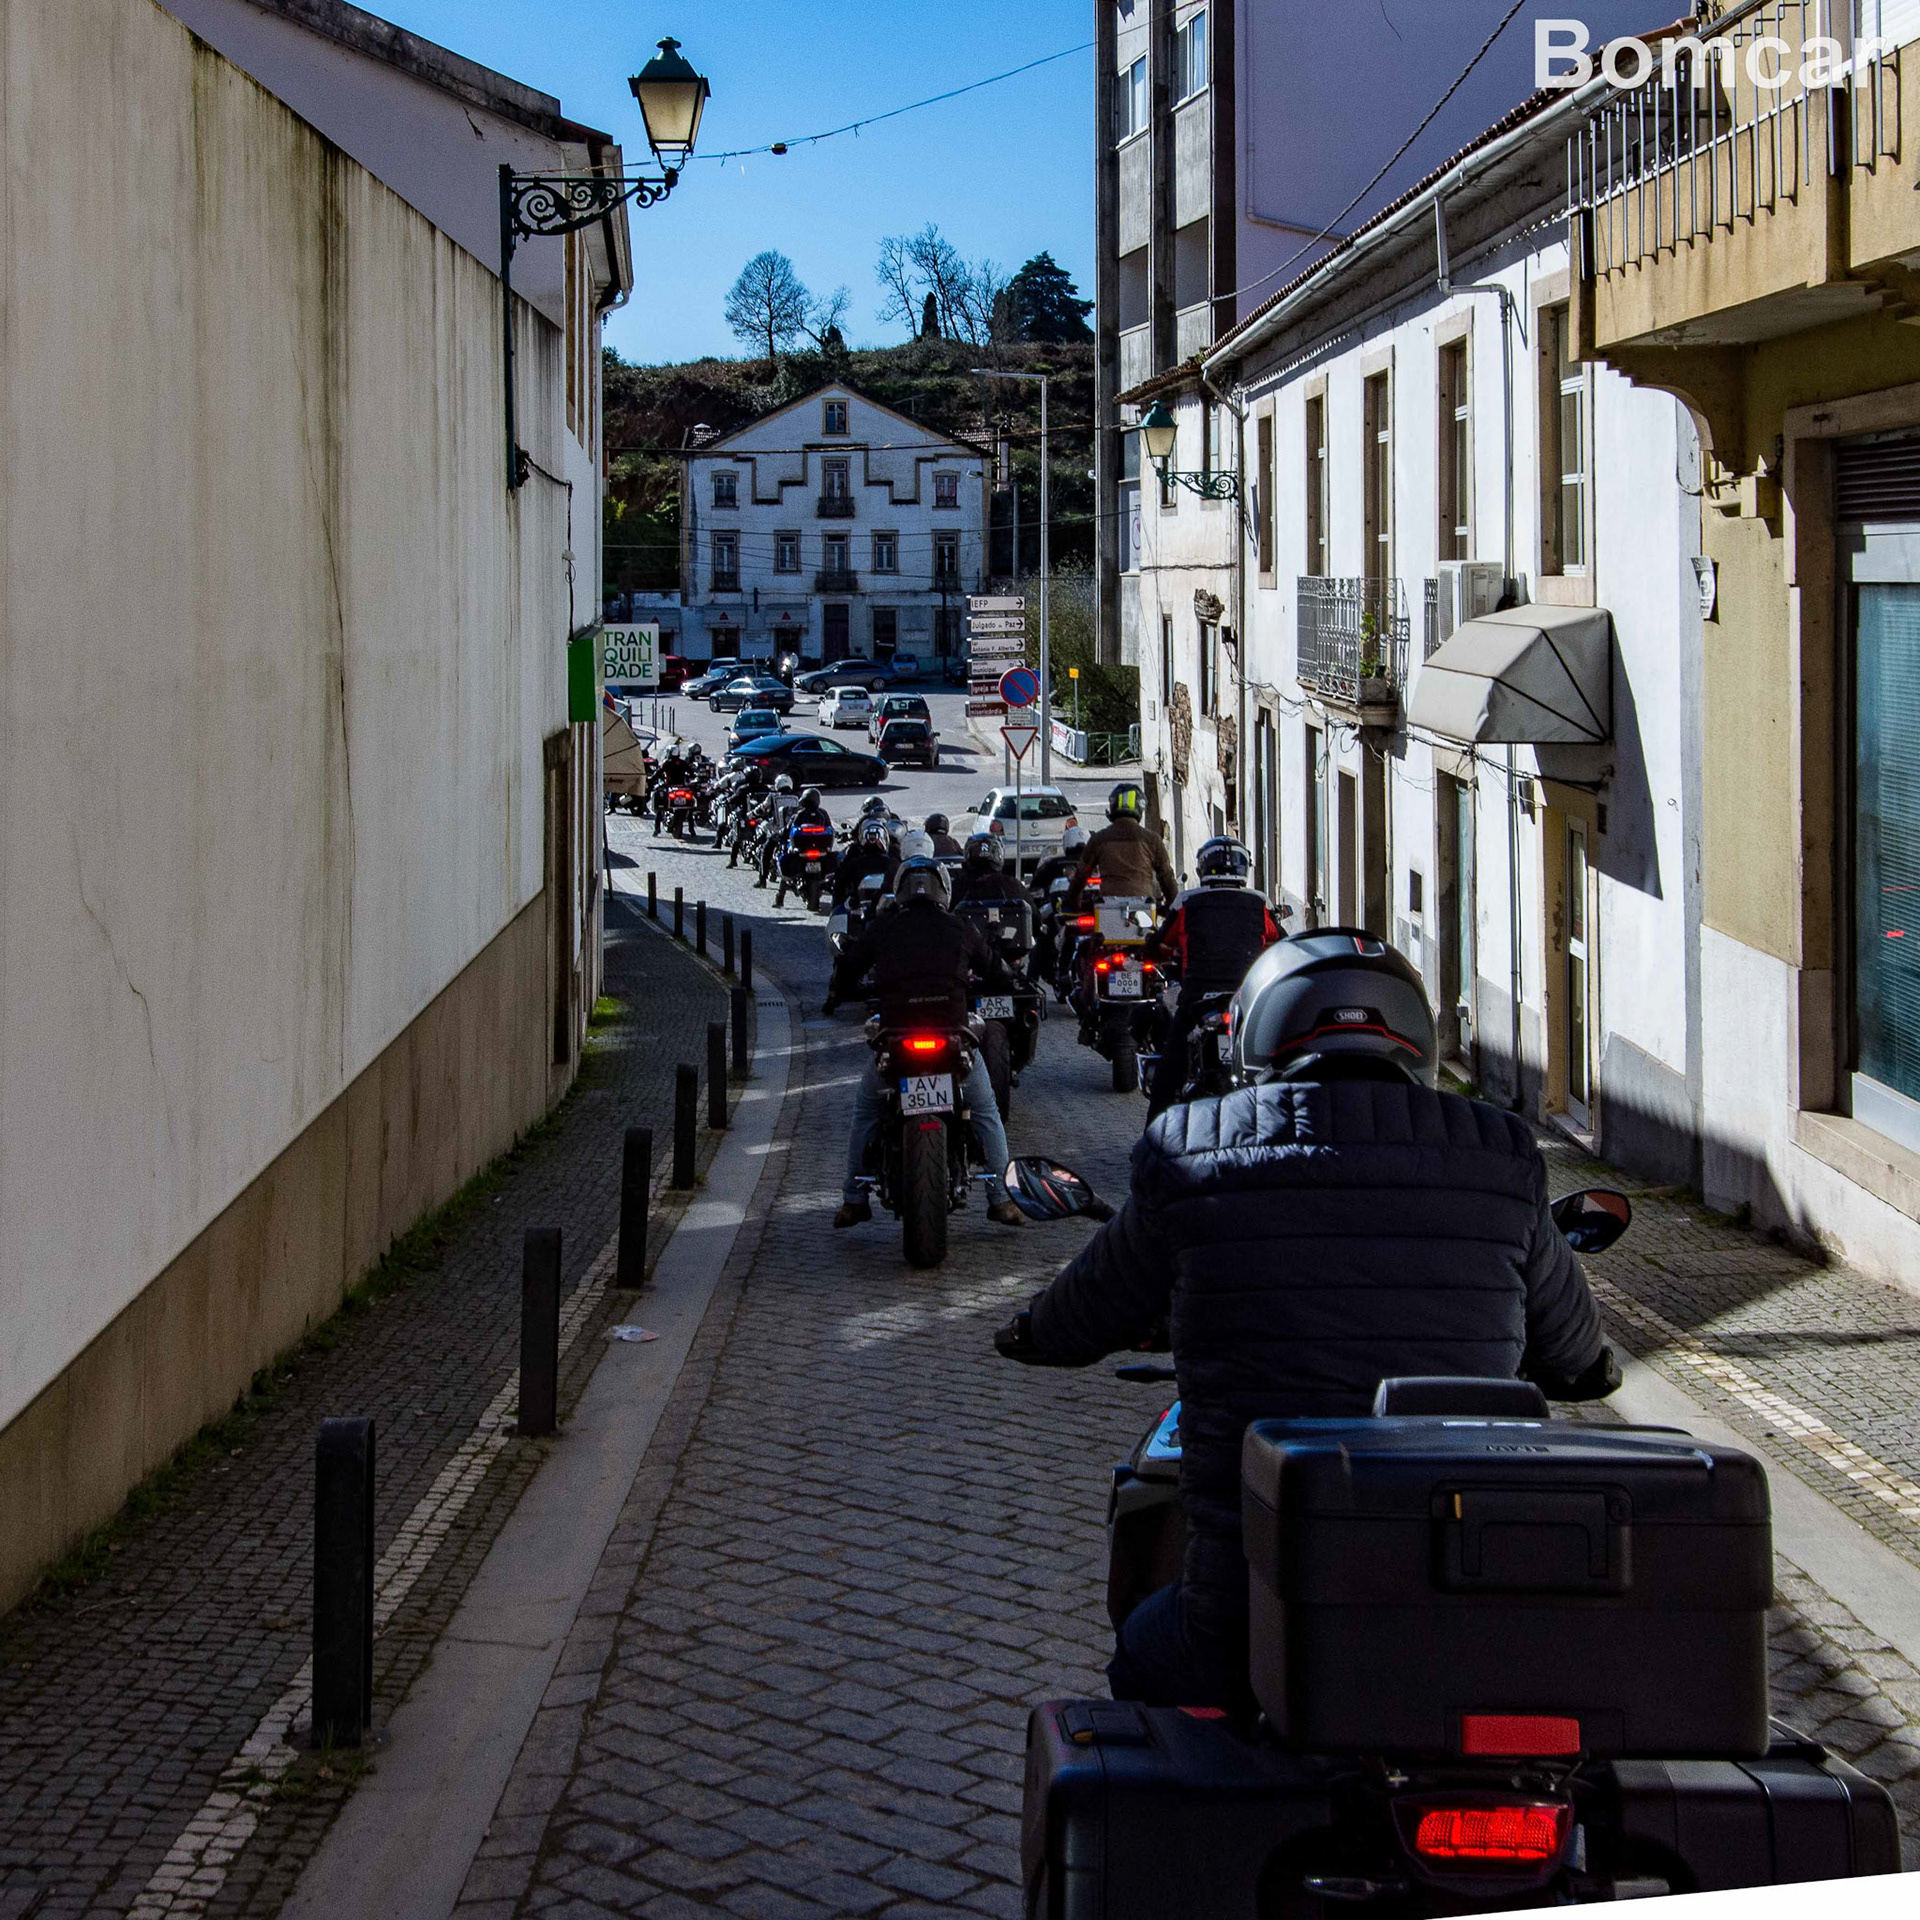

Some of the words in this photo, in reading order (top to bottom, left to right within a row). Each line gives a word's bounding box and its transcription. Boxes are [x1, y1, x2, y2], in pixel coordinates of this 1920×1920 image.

[972, 599, 988, 608] IEFP
[972, 621, 996, 630] Julgado
[1005, 621, 1016, 629] Paz
[604, 631, 652, 646] TRAN
[604, 647, 652, 664] QUILI
[604, 663, 653, 678] DADE
[1121, 972, 1132, 980] BE
[1121, 986, 1133, 994] AC
[986, 997, 1004, 1007] AR
[980, 1006, 1011, 1017] 92ZR
[1339, 1011, 1364, 1020] SHOEI
[915, 1077, 938, 1092] AV
[907, 1090, 948, 1108] 35LN
